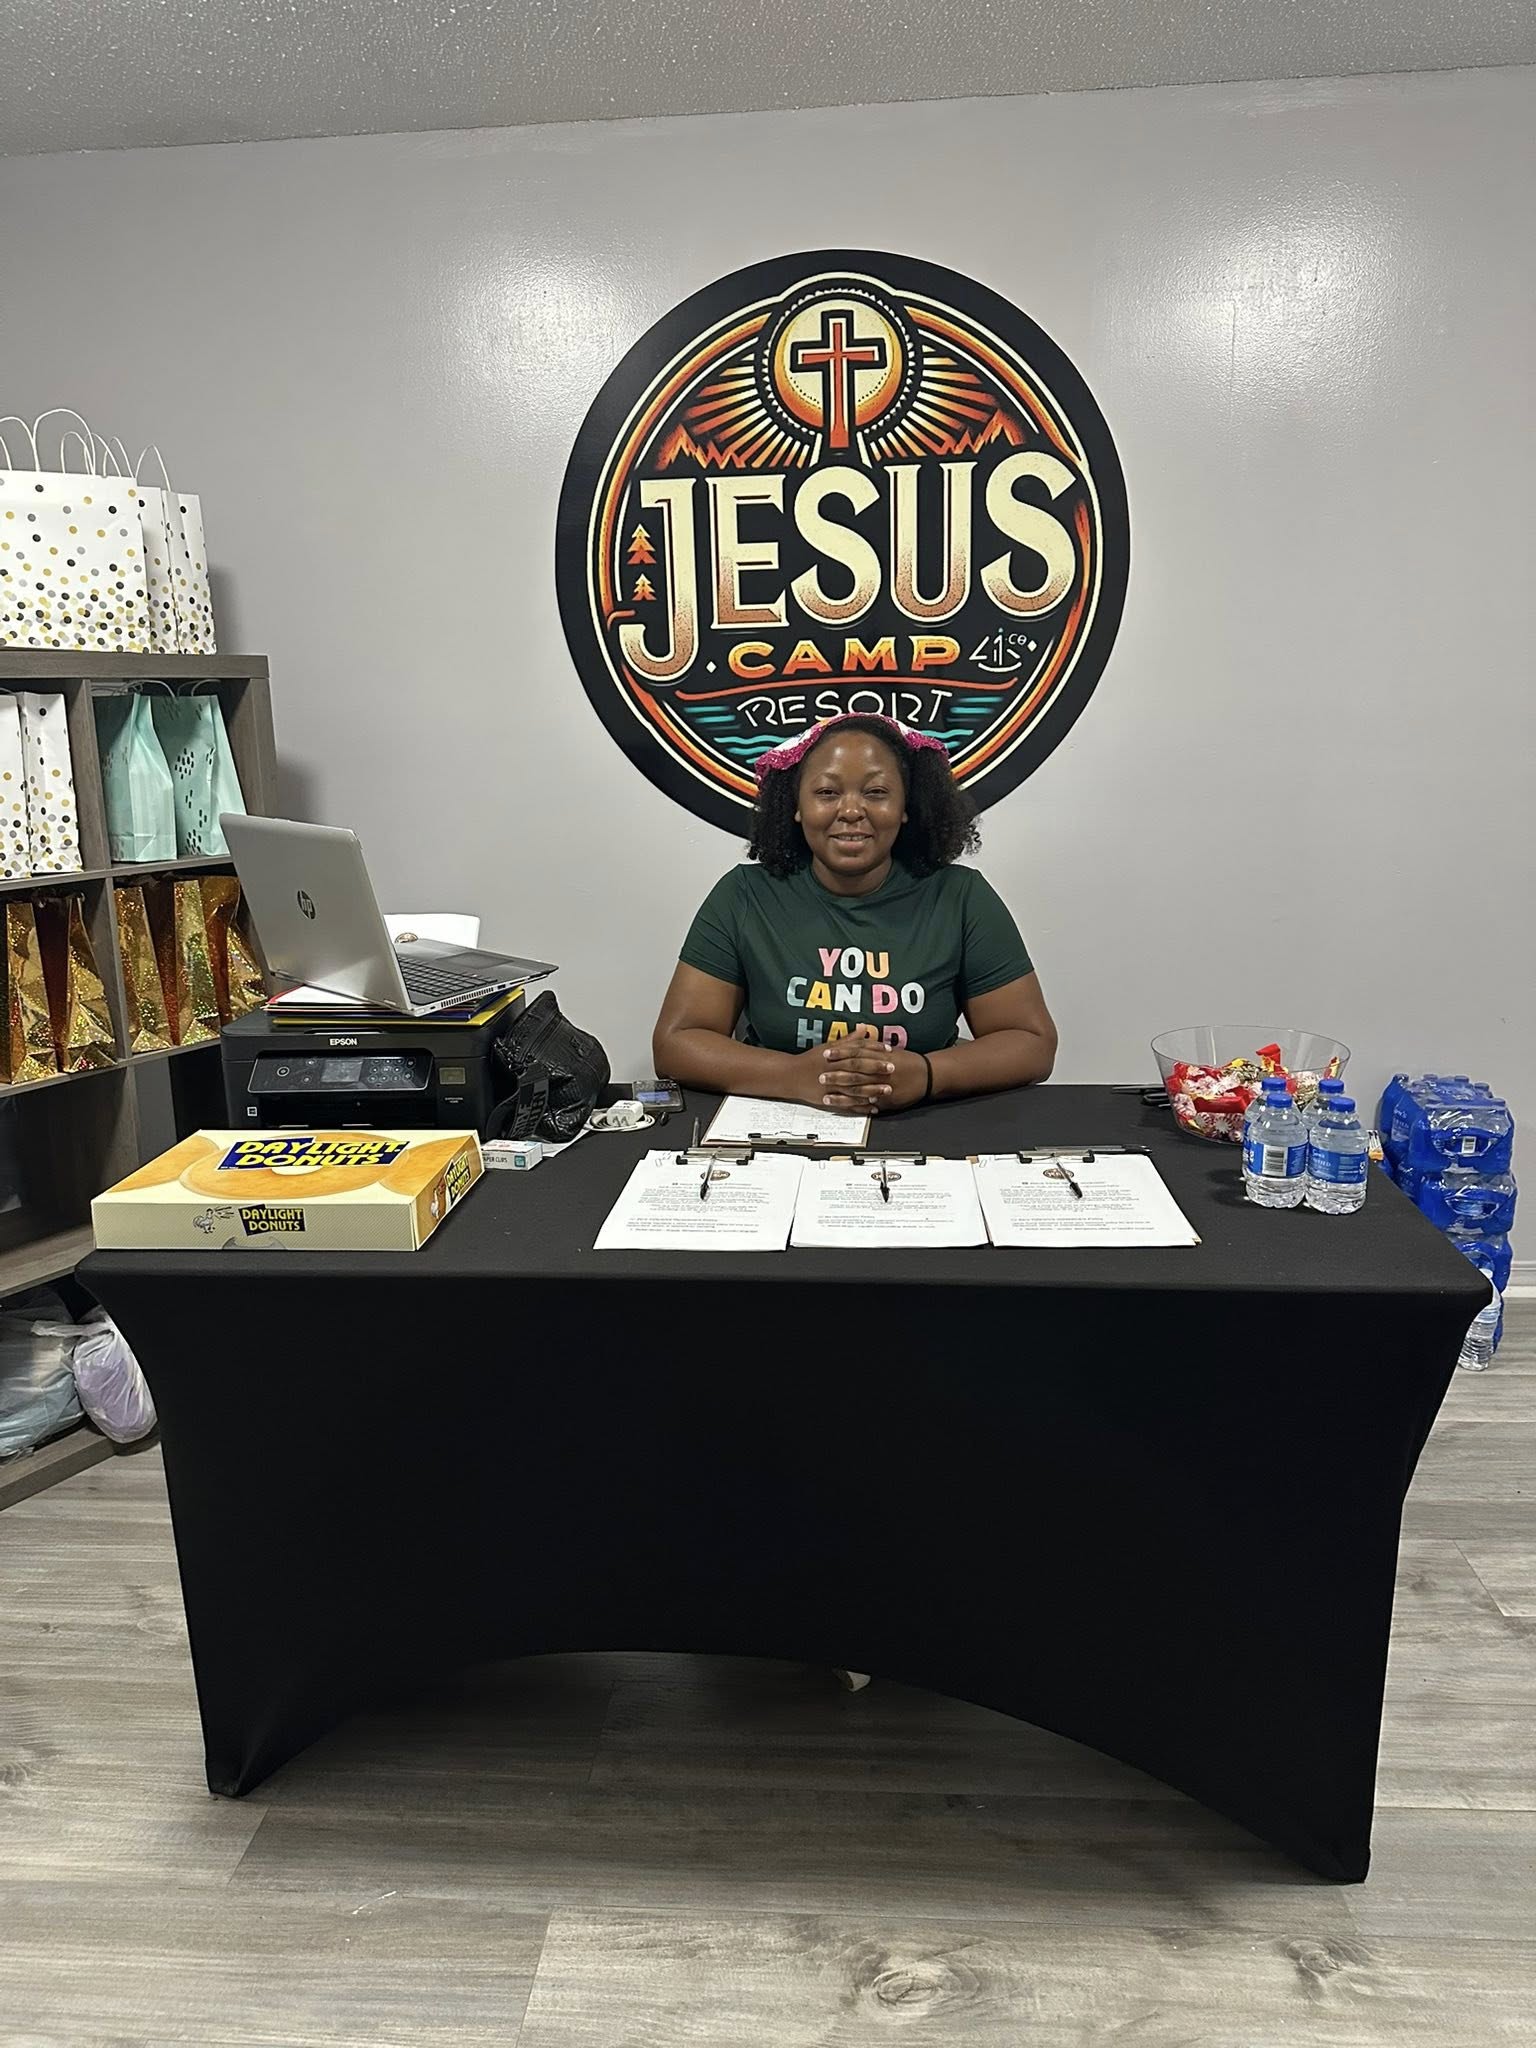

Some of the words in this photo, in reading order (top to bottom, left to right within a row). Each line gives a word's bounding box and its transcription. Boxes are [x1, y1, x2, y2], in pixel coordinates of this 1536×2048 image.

[619, 451, 1077, 681] JESUS
[728, 635, 961, 679] CAMP
[737, 688, 952, 728] RESORT
[818, 946, 890, 979] YOU
[787, 976, 862, 1013] CAN
[872, 982, 925, 1014] DO
[329, 1038, 358, 1046] EPSON
[235, 1153, 384, 1167] DONUTS
[242, 1208, 303, 1220] DAYLIGHT
[248, 1219, 301, 1232] DONUTS
